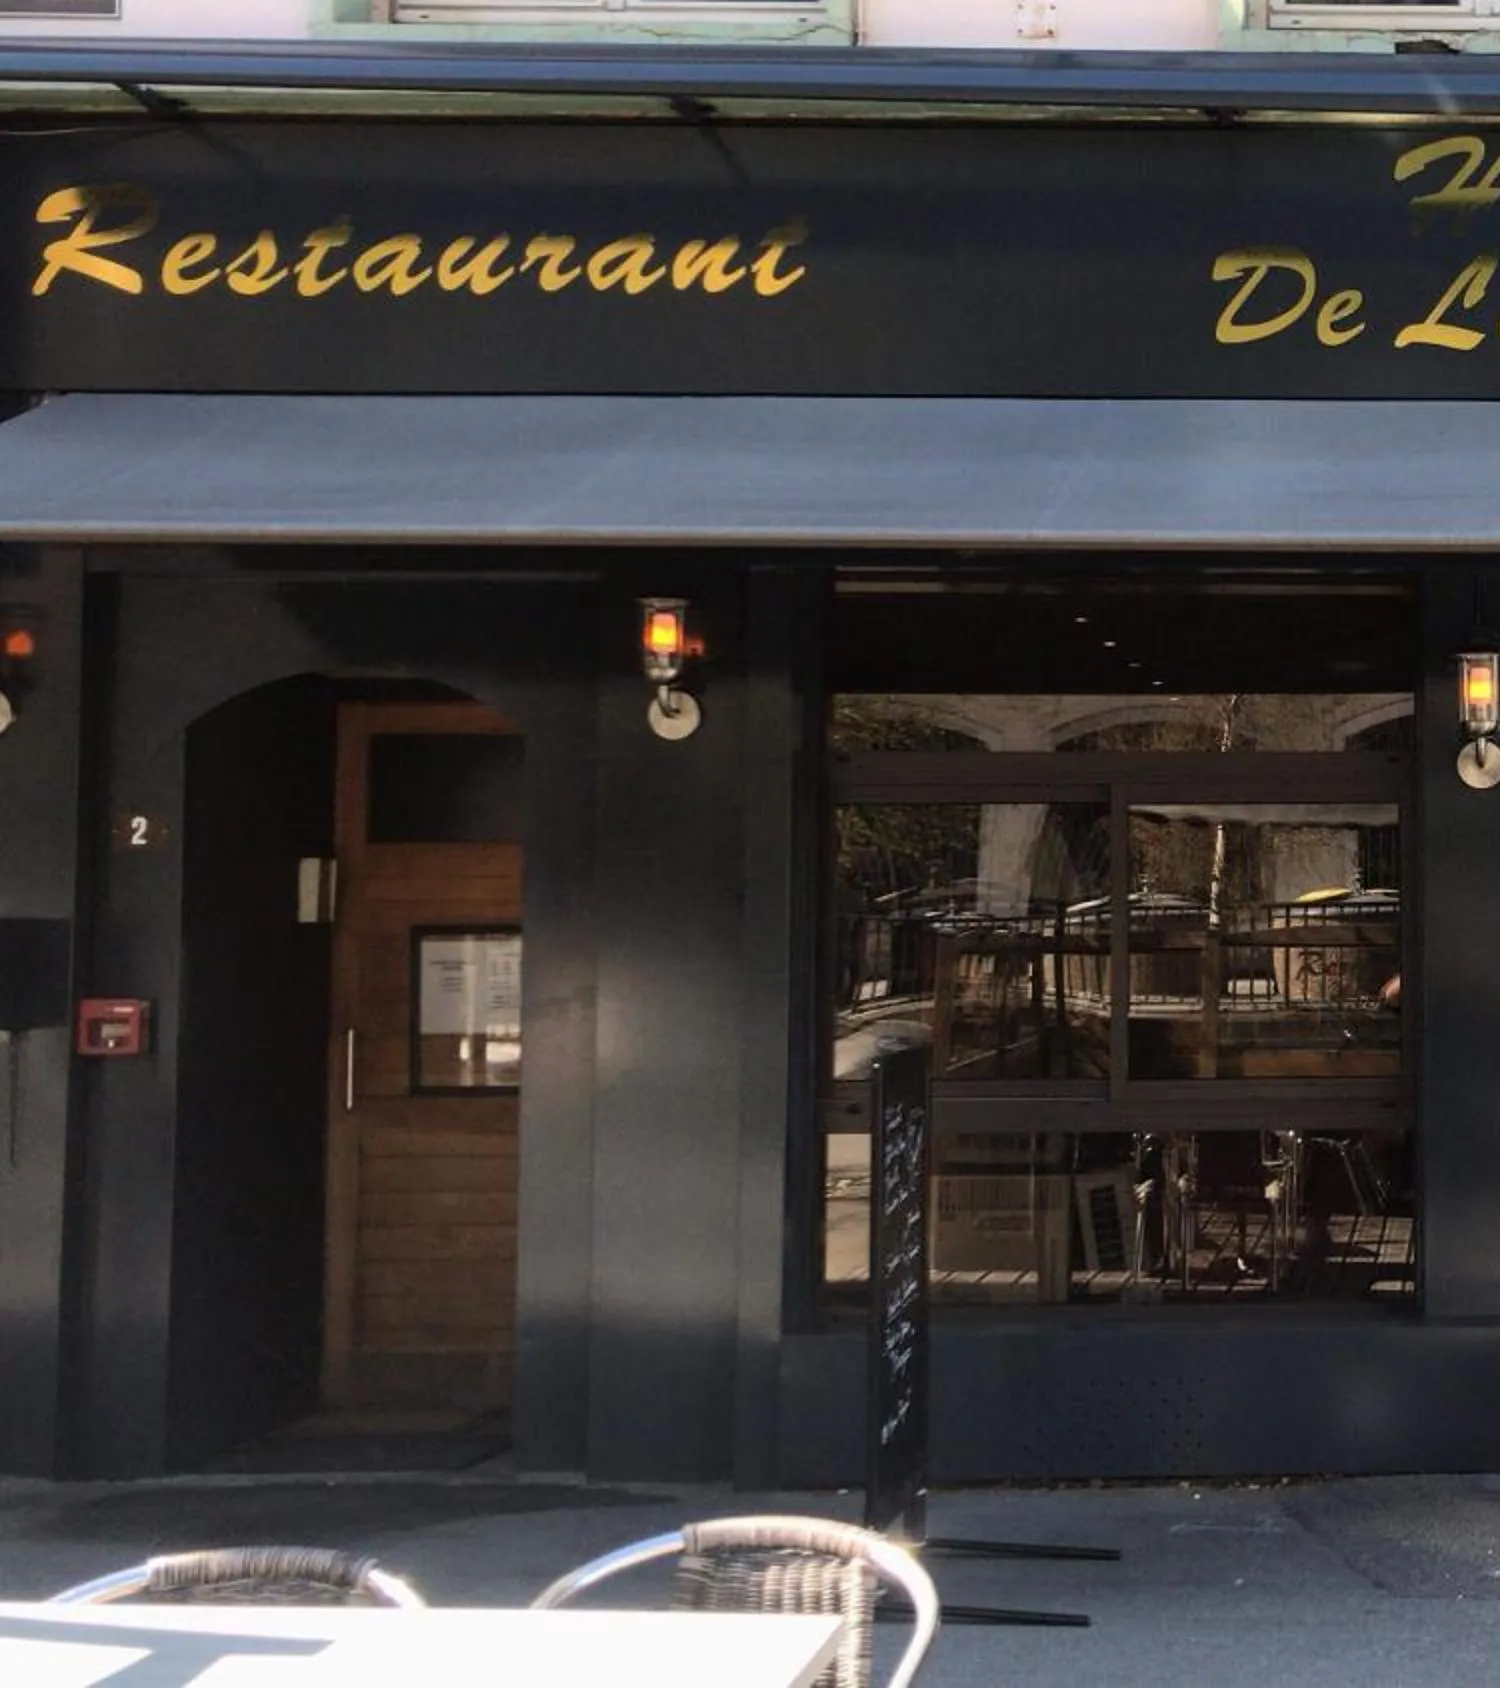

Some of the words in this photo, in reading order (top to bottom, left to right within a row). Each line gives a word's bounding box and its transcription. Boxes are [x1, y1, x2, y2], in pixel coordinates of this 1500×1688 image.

[32, 184, 807, 297] Restaurant
[1210, 246, 1367, 346] De
[130, 816, 148, 845] 2
